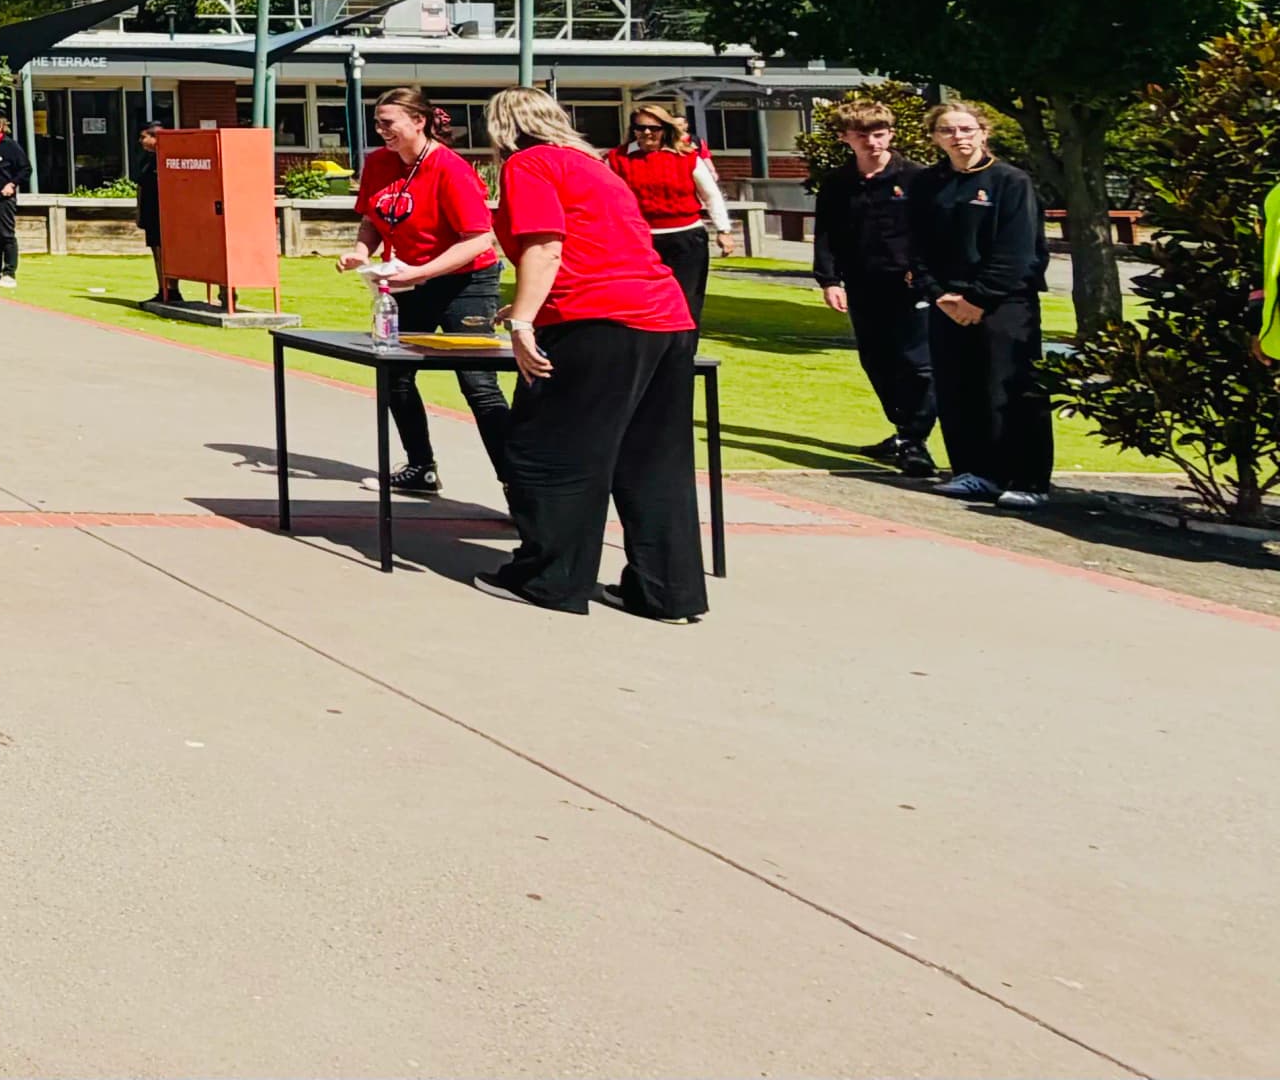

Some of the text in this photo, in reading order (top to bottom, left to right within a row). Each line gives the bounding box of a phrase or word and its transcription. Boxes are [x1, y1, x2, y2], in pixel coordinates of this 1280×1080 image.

[32, 56, 108, 69] HE TERRACE
[166, 158, 211, 170] FIRE HYDRANT
